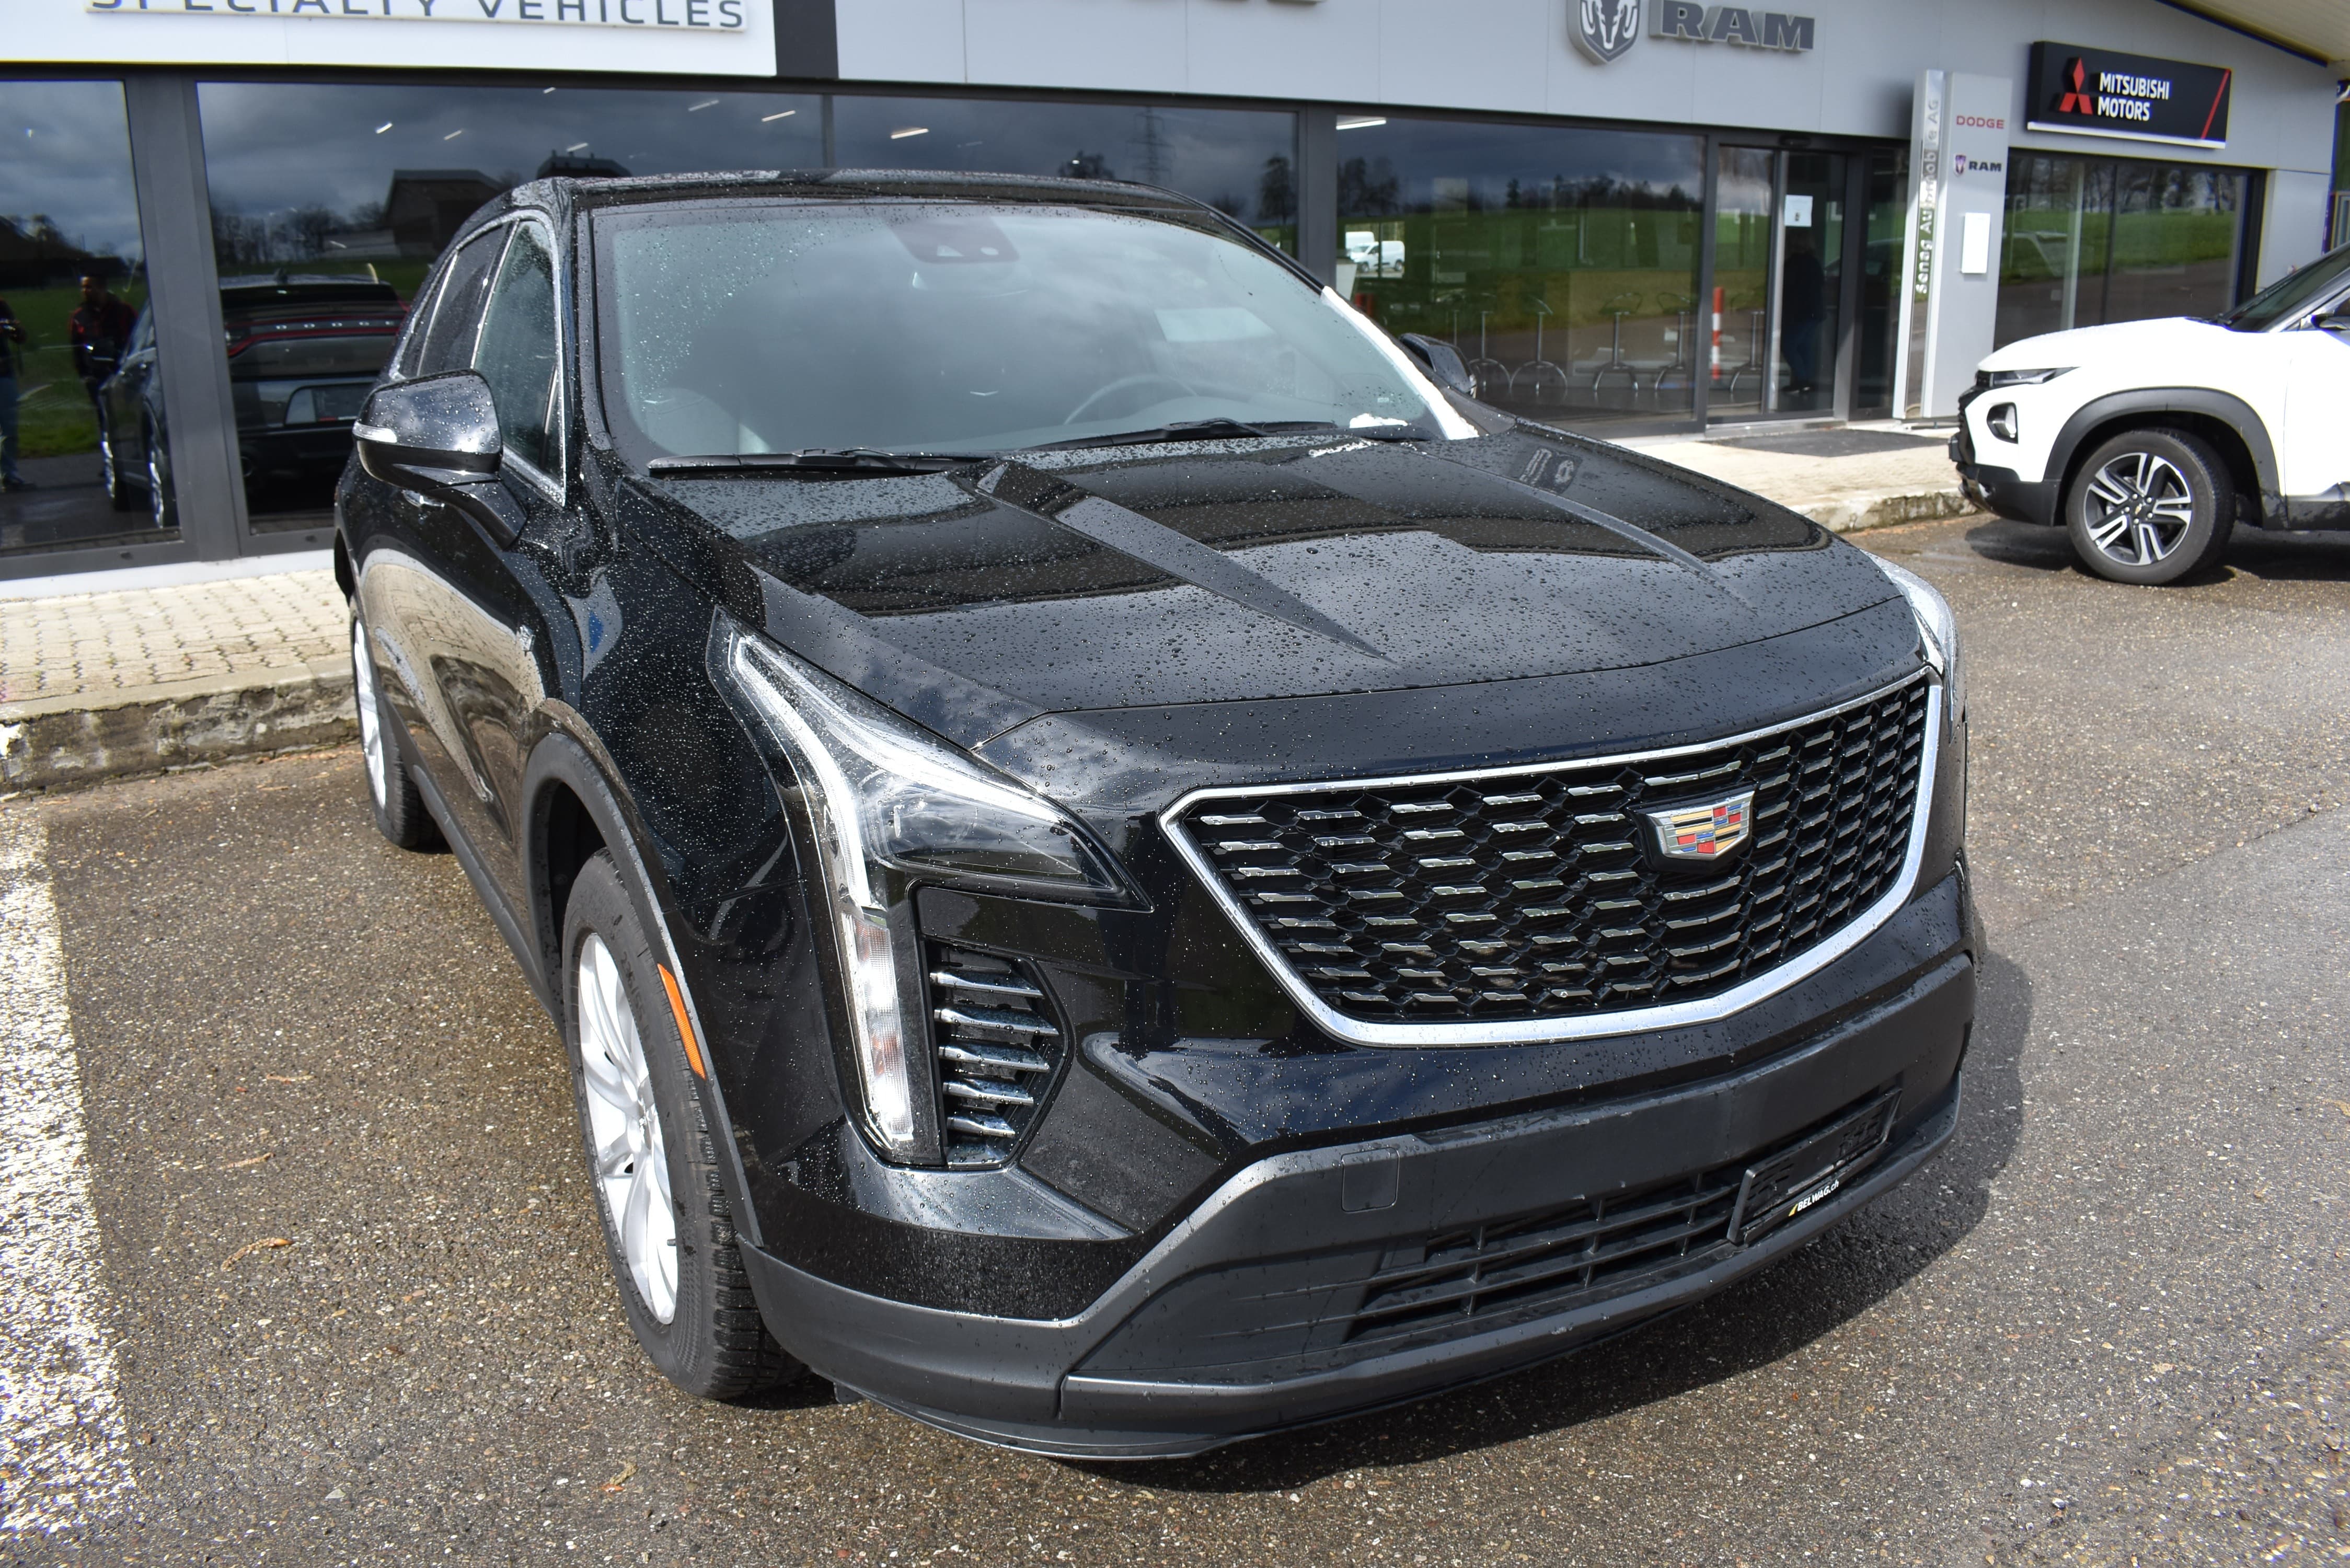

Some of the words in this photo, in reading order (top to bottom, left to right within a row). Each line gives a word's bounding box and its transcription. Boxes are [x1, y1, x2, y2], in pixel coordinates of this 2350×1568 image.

[477, 0, 743, 28] VEHICLES
[1661, 0, 1815, 50] RAM
[2099, 72, 2170, 100] MITSUBISHI
[1928, 100, 1939, 124] AG
[1956, 115, 2005, 129] DODGE
[2098, 96, 2150, 122] MOTORS
[1969, 161, 2002, 172] RAM
[1919, 130, 1937, 234] Auomobe
[1916, 239, 1933, 294] Senag
[1797, 1179, 1839, 1212] BELWAG.ch
